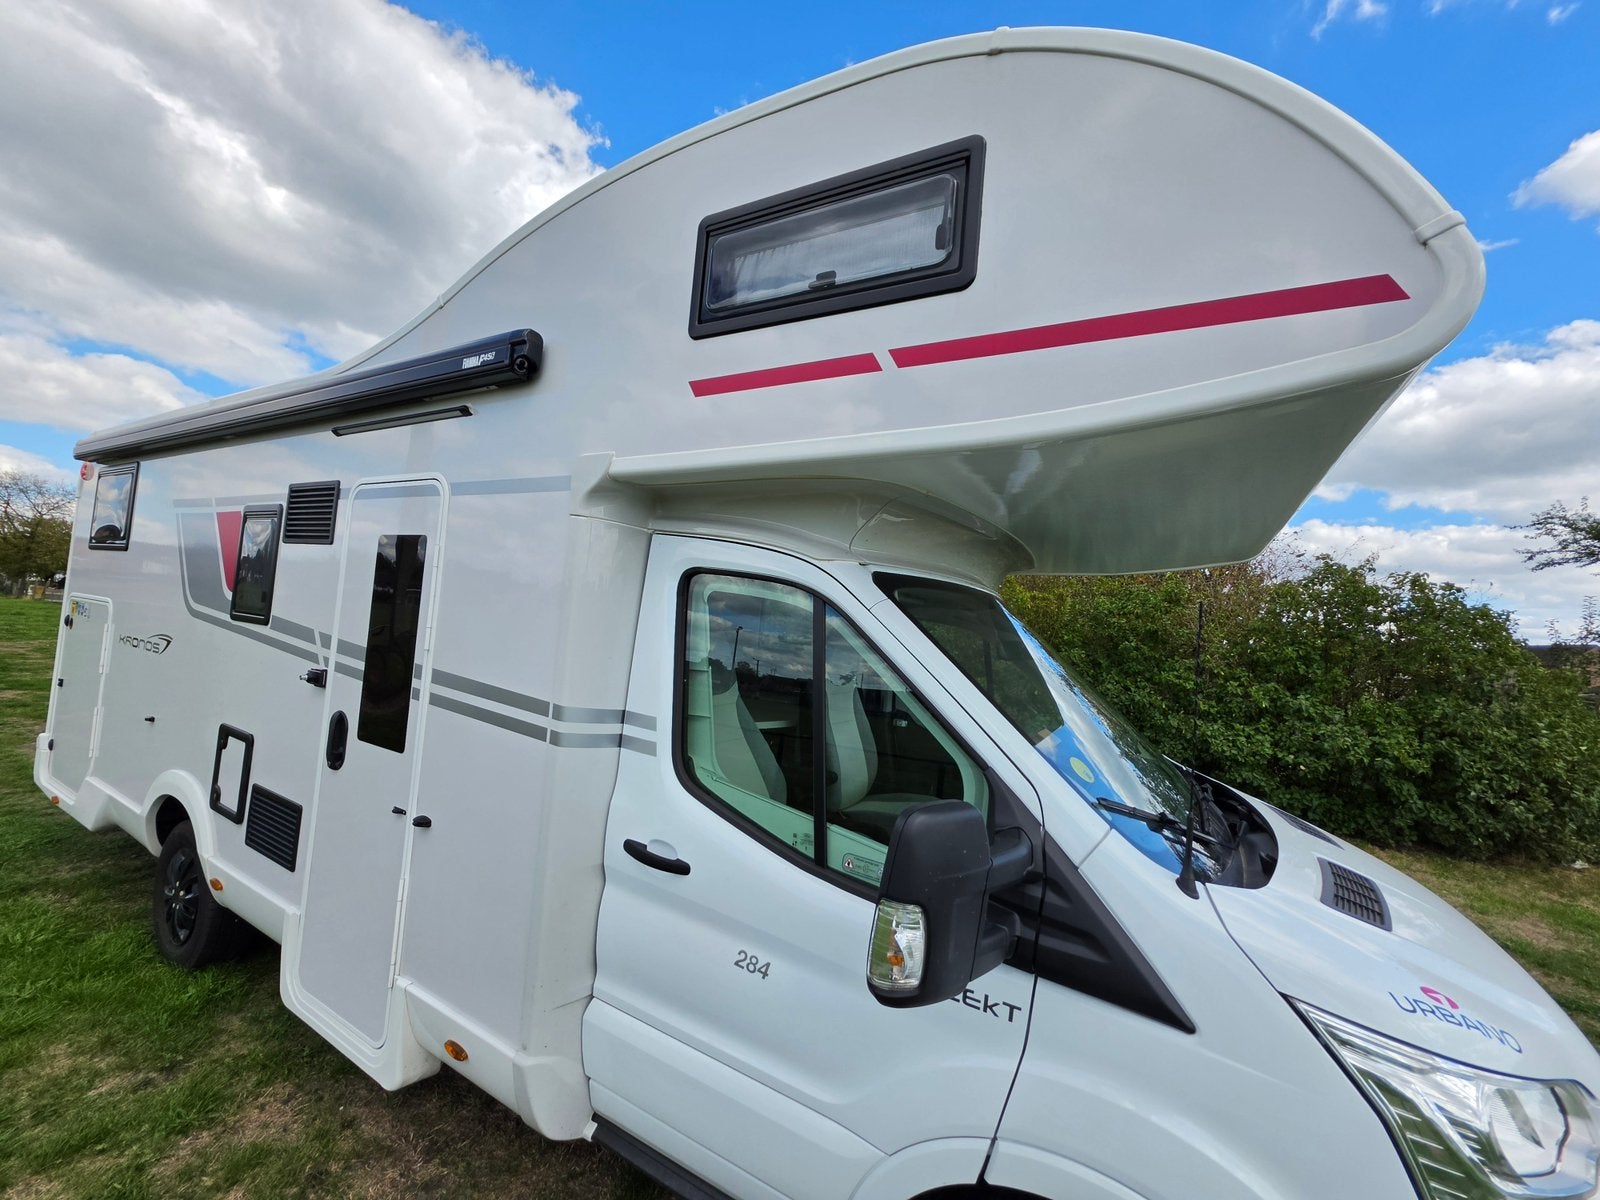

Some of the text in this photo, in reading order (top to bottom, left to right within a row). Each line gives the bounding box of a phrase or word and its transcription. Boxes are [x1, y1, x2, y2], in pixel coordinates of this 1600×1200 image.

[119, 634, 160, 654] KRONOS
[733, 949, 772, 980] 284
[950, 987, 1022, 1023] EKT
[1388, 991, 1523, 1054] URBANO
